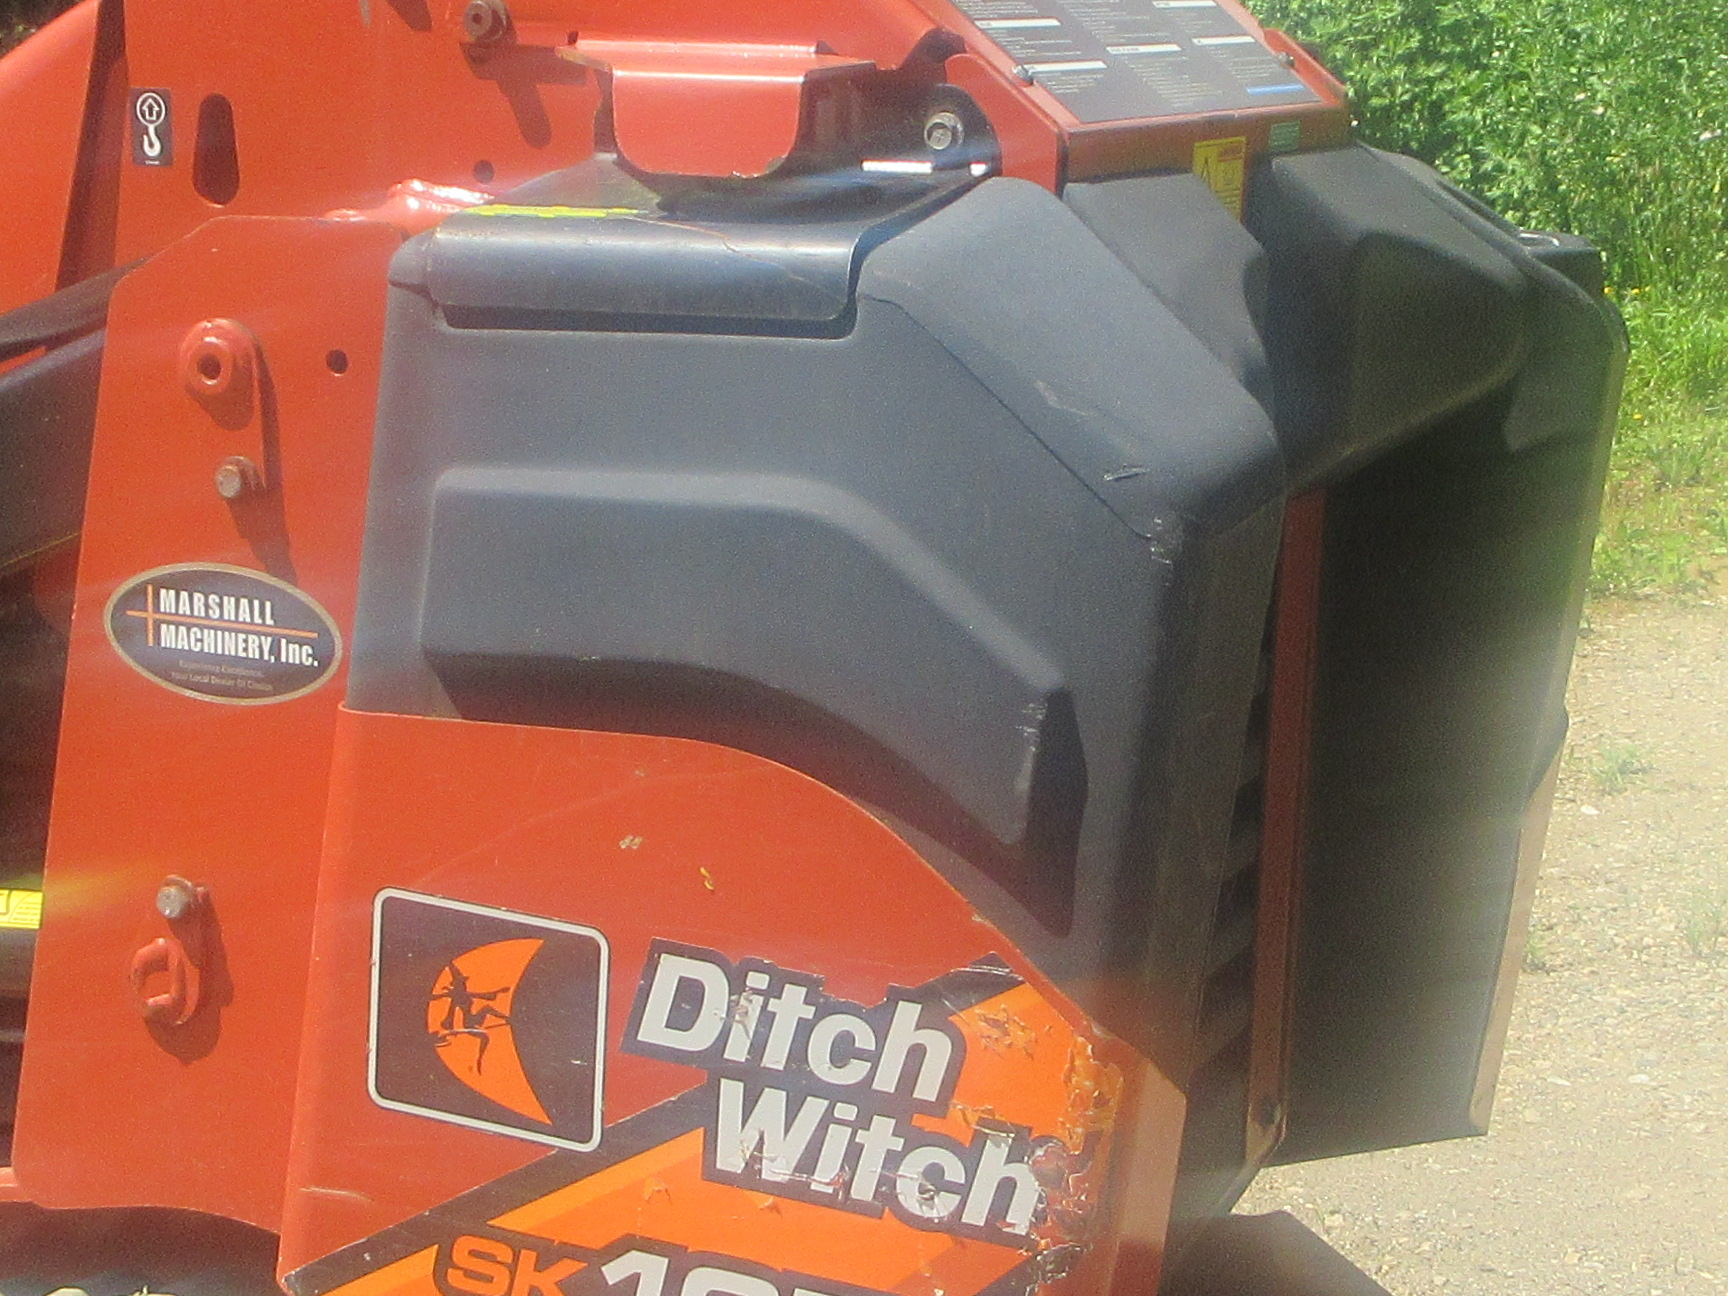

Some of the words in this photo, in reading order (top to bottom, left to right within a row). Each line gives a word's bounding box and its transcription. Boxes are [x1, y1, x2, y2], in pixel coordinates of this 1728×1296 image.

[158, 587, 275, 626] MARSHALL
[159, 623, 276, 664] MACHINERY,
[280, 637, 319, 667] Inc.
[635, 952, 953, 1102] Ditch
[716, 1078, 1040, 1236] Witch
